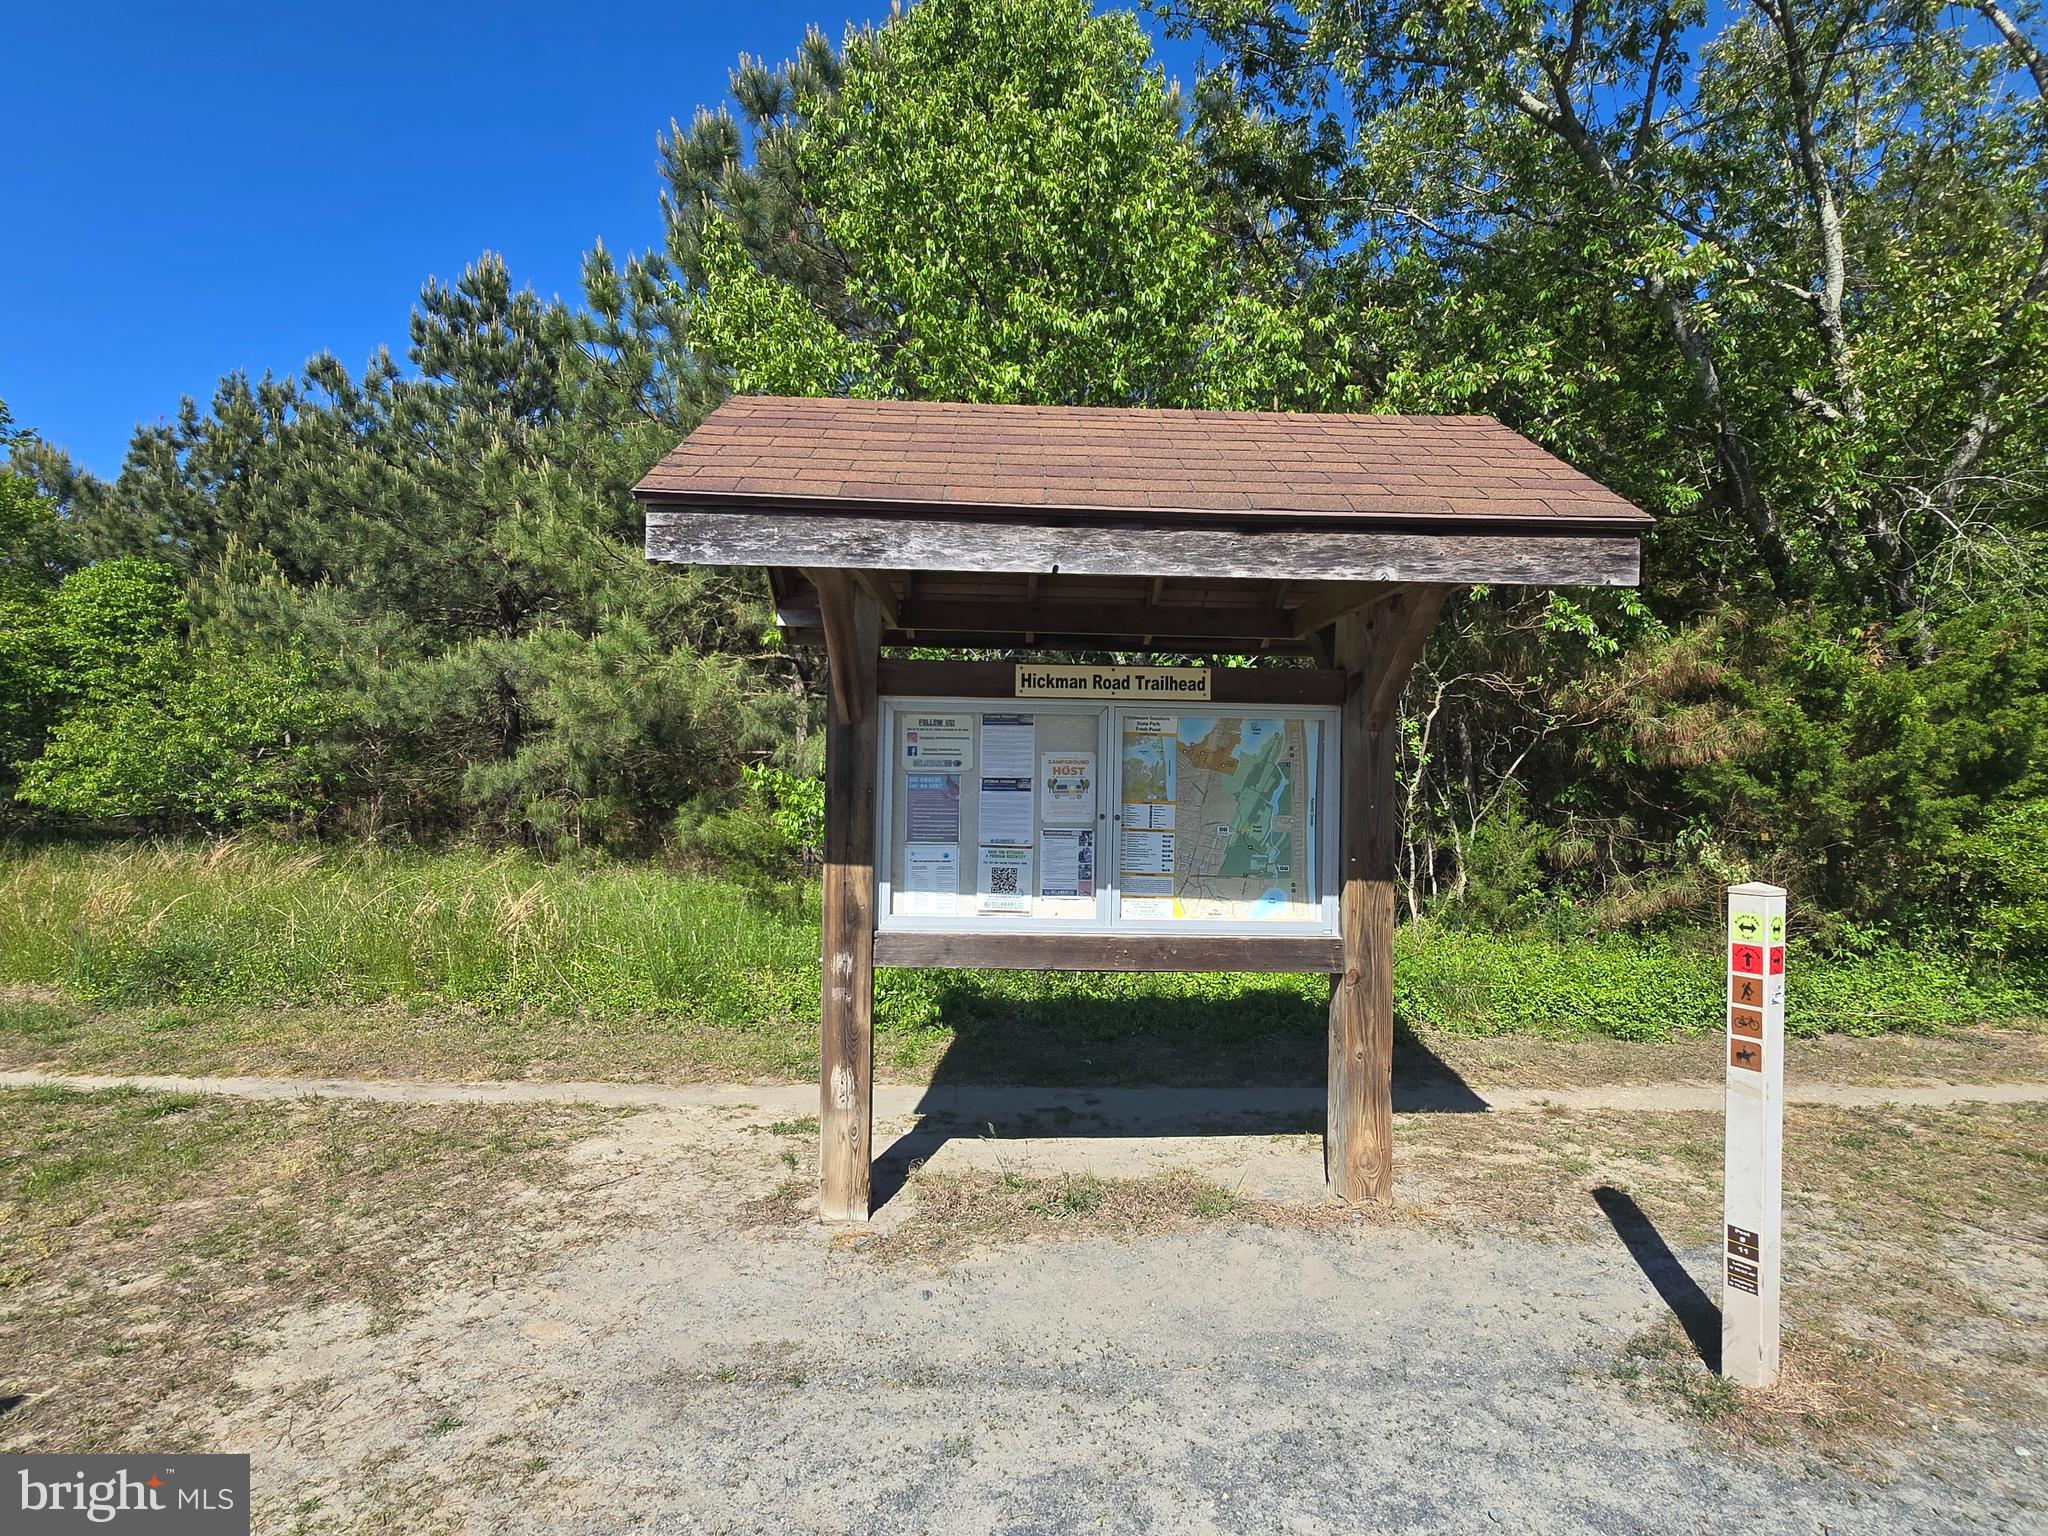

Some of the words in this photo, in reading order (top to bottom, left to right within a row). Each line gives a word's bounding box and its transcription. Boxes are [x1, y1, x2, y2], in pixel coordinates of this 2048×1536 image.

[1020, 673, 1087, 689] Hickman
[1092, 674, 1130, 690] Road
[1135, 675, 1206, 691] Trailhead
[918, 718, 943, 727] FOLLOW
[1052, 766, 1086, 776] HOST
